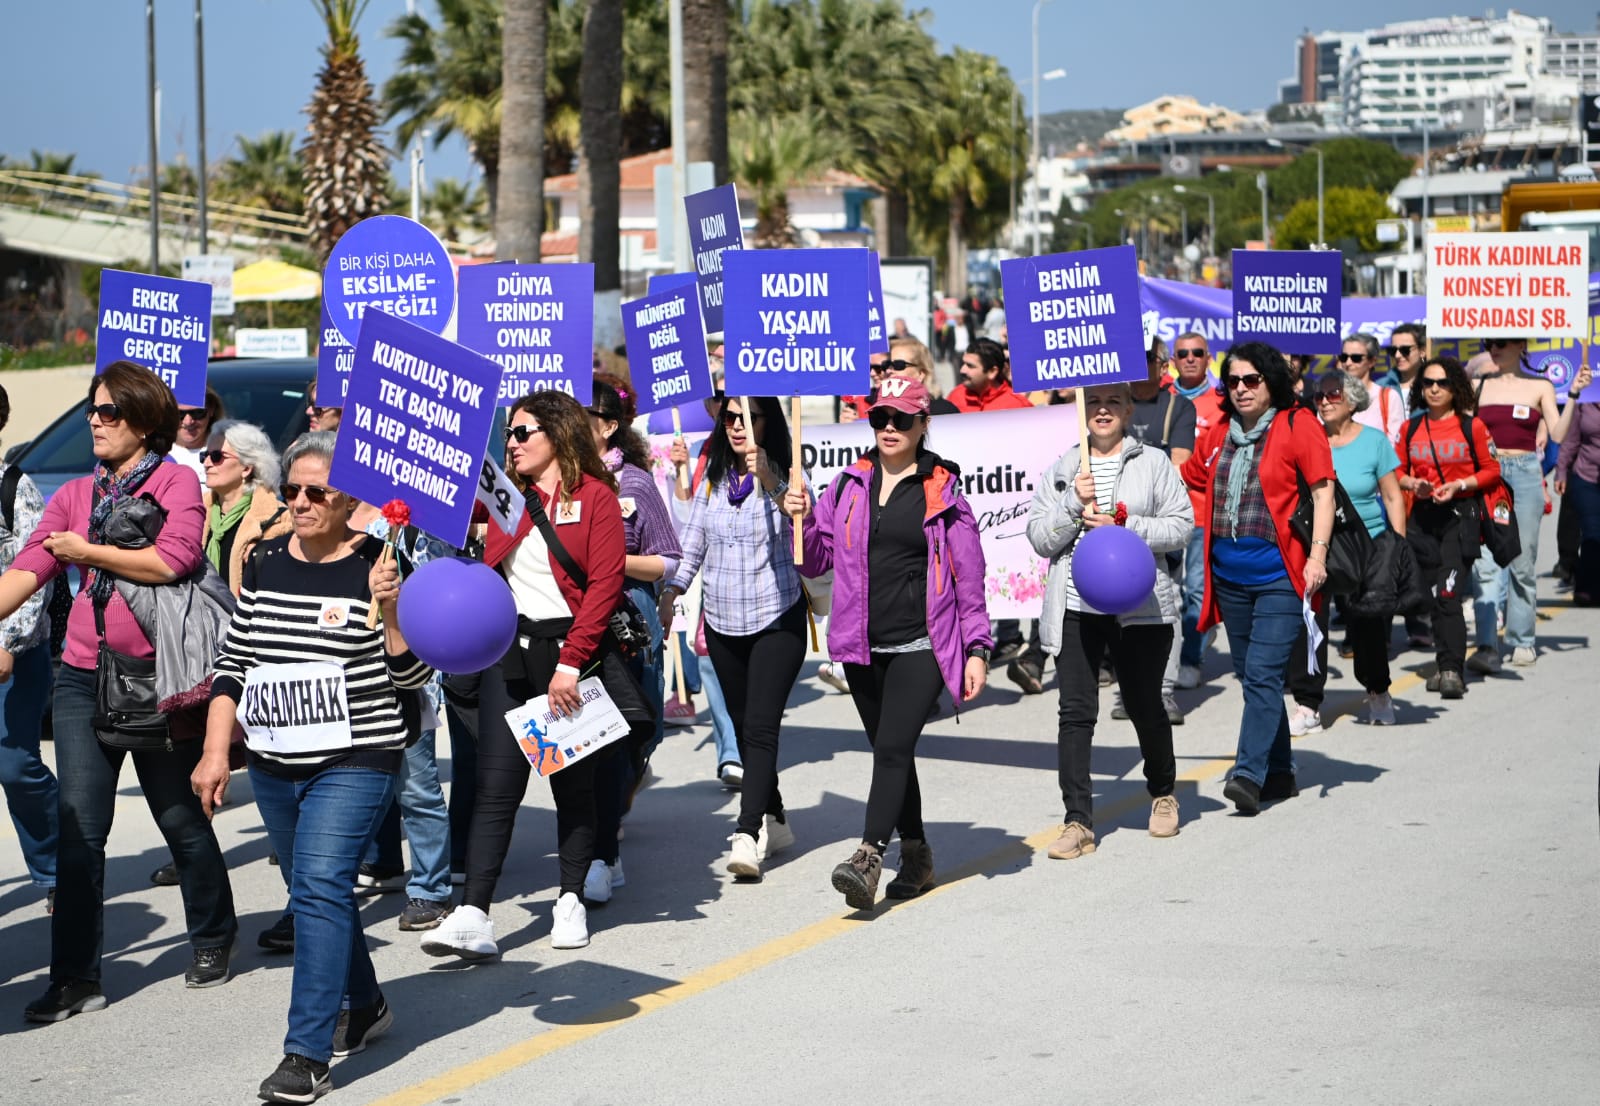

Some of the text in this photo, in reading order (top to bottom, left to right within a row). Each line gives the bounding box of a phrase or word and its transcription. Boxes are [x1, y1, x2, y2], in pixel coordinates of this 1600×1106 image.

[701, 213, 727, 241] KADIN
[340, 252, 436, 274] BİR KİŞİ DAHA
[697, 237, 741, 276] CİNAYE
[1434, 242, 1582, 266] TÜRK KADINLAR
[342, 273, 437, 295] EKSİLME-
[497, 272, 552, 296] DÜNYA
[761, 273, 829, 297] KADIN
[1038, 262, 1101, 292] BENİM
[1244, 272, 1328, 294] KATLEDİLEN
[1443, 272, 1522, 297] KONSEYİ
[1528, 277, 1571, 297] DER.
[132, 287, 179, 313] ERKEK
[484, 298, 563, 322] YERİNDEN
[635, 295, 685, 328] MÜNFERİT
[1029, 290, 1115, 323] BEDENİM
[1250, 296, 1322, 314] KADINLAR
[102, 309, 207, 343] ADALET DEĞİL
[759, 310, 831, 341] YAŞAM
[1237, 311, 1336, 334] İSYANIMIZDIR
[1442, 308, 1571, 330] KUŞADASI ŞB.
[497, 328, 551, 347] OYNAR
[649, 323, 680, 350] DEĞİL
[1044, 320, 1106, 351] BENİM
[123, 338, 182, 369] GERÇEK
[485, 353, 563, 373] ADINLAR
[651, 350, 684, 375] ERKEK
[738, 341, 856, 372] ÖZGÜRLÜK
[1036, 351, 1120, 381] KARARIM
[372, 340, 449, 399] KURTULUŞ
[452, 374, 484, 409] YOK
[651, 370, 691, 404] ŞİDDETİ
[880, 378, 911, 398] W
[379, 378, 407, 410] TEK
[407, 391, 461, 436] BAŞINA
[354, 403, 473, 478] YA HEP BERABER
[354, 438, 459, 508] YA HİÇBİRİMİZ
[958, 464, 1034, 496] ridir.
